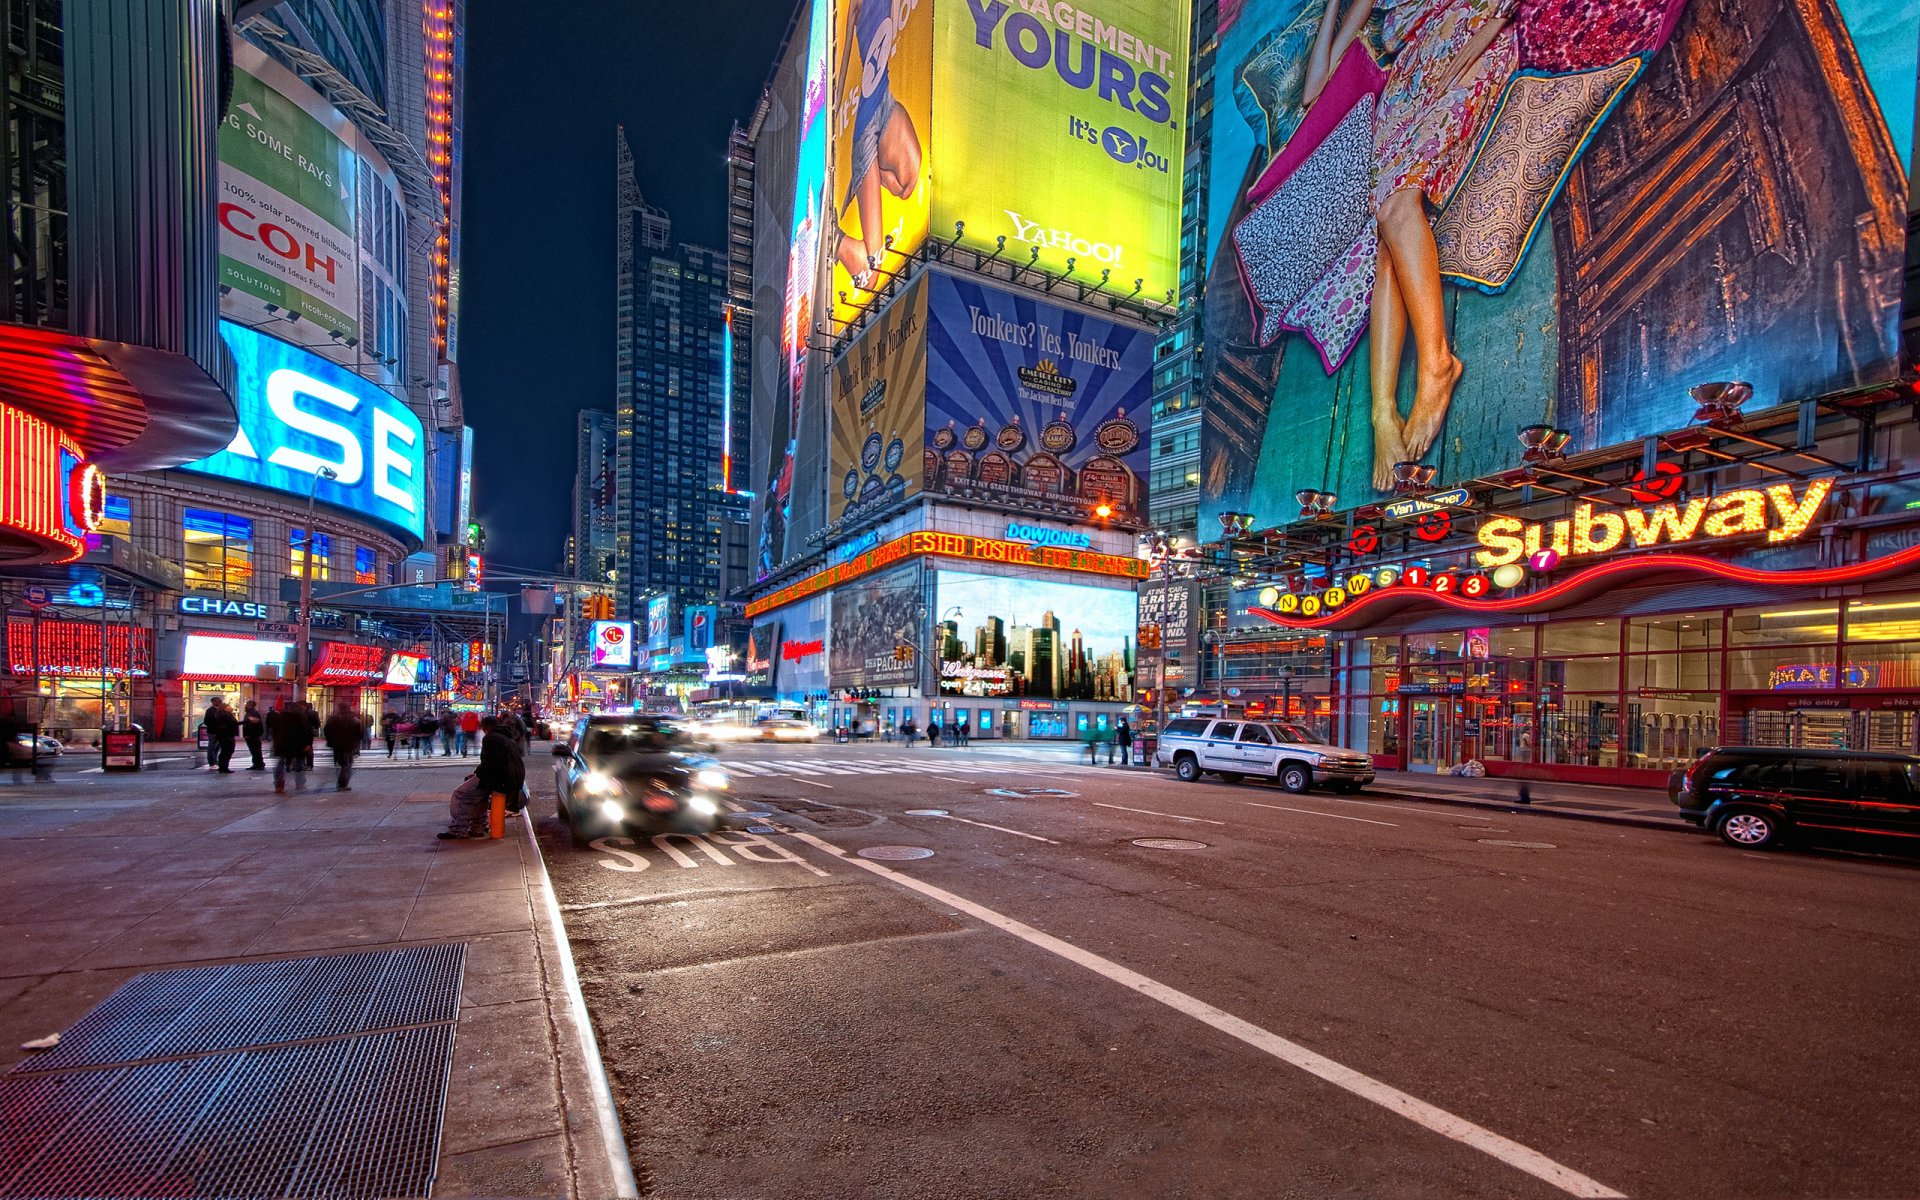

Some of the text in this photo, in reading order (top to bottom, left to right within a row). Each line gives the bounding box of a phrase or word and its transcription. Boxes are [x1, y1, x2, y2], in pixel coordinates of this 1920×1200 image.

[966, 0, 1177, 130] YOURS.
[839, 85, 859, 136] It's
[1069, 115, 1098, 145] It's
[247, 123, 293, 161] SOME
[298, 154, 333, 188] RAYS
[224, 181, 353, 262] 100% solar powered billboard.
[1003, 209, 1123, 269] YAHOO!
[227, 267, 282, 297] SOLUTIONS
[257, 252, 336, 298] Moving Ideas Forward
[301, 300, 352, 333] ricoh-eco.com
[969, 305, 1122, 371] Yonkers? Yes, Yonkers.
[1033, 377, 1062, 389] CASINO
[225, 367, 416, 513] SE
[954, 477, 970, 486] EXIT
[971, 479, 977, 487] 2
[978, 481, 989, 490] NY
[990, 483, 1010, 493] STATE
[1010, 486, 1043, 499] THRUWAY
[1391, 503, 1413, 516] Van
[1476, 477, 1836, 568] Subway
[1149, 592, 1188, 605] RACES
[1179, 601, 1188, 610] A
[1282, 571, 1481, 613] N Q R W S 1 2 3
[182, 597, 268, 619] CHASE
[269, 624, 281, 632] 42
[941, 661, 1008, 680] Walgreens
[941, 680, 1007, 693] open 24 hours
[1815, 699, 1840, 707] entry
[589, 831, 831, 876] BUS
